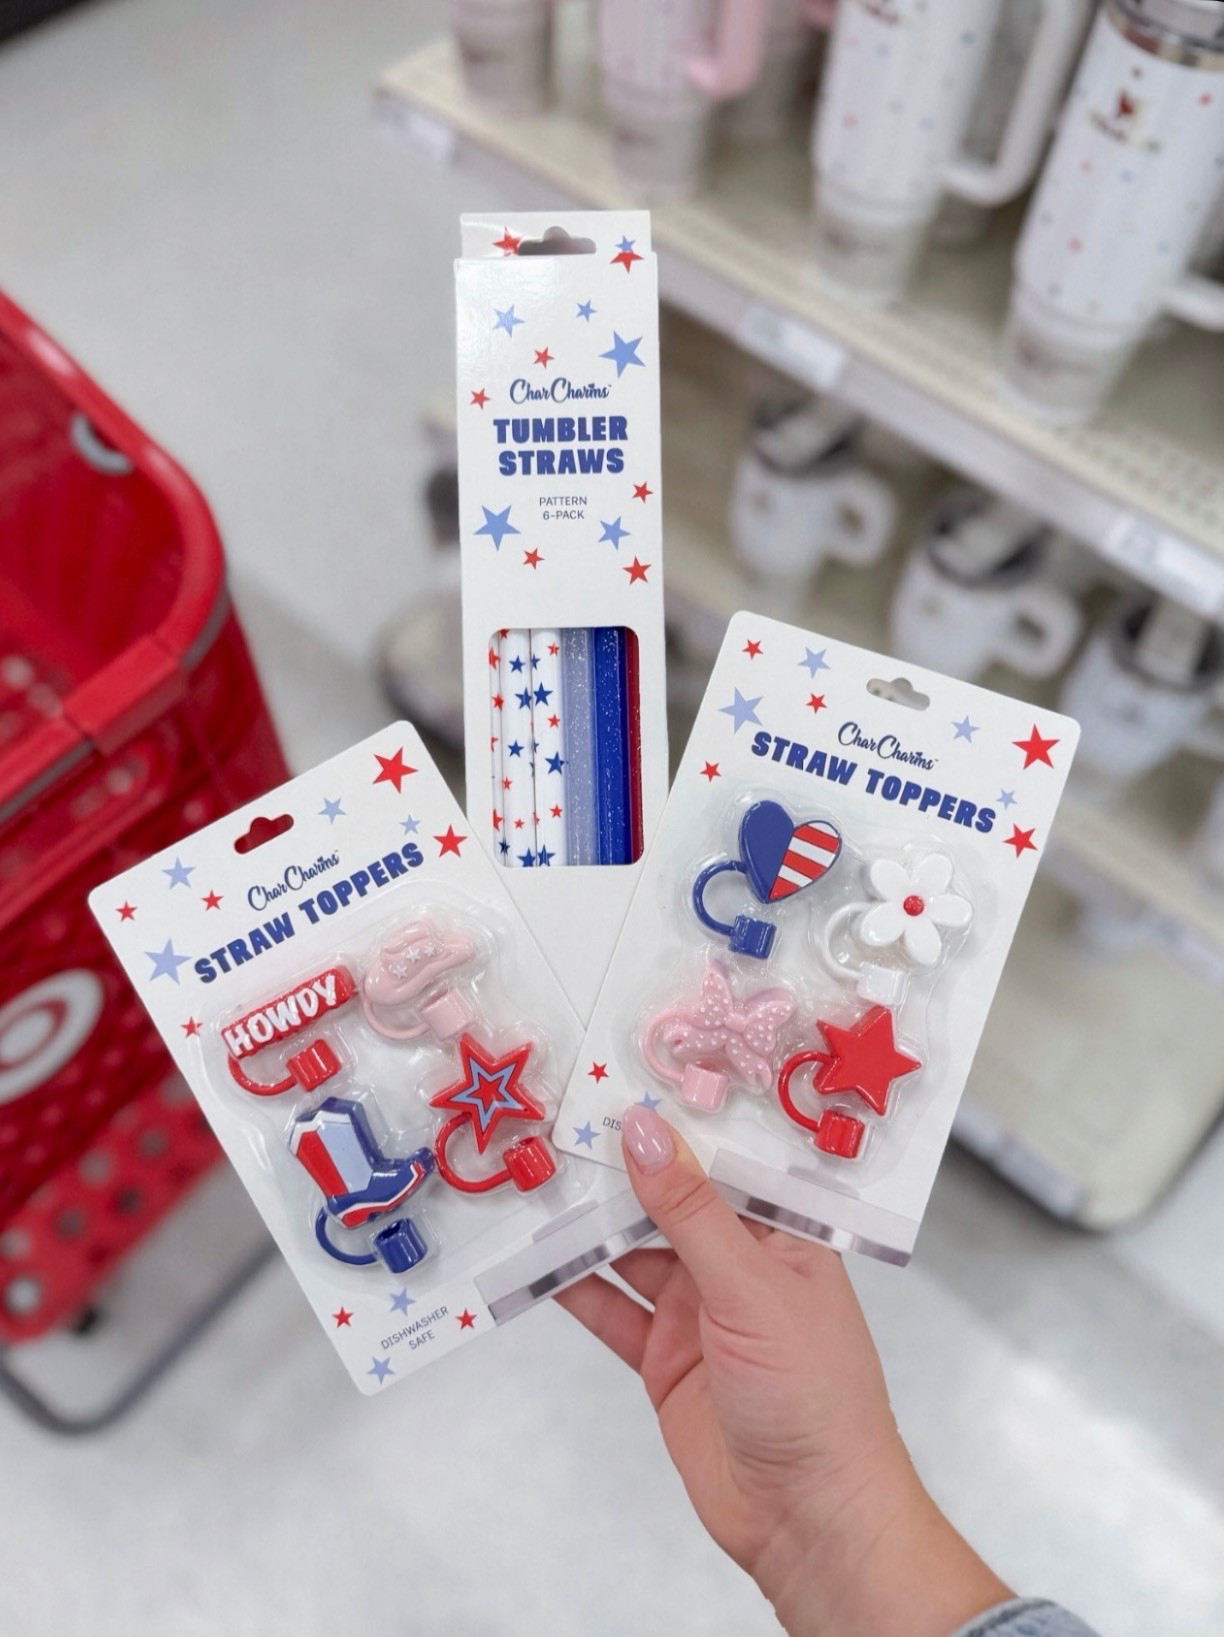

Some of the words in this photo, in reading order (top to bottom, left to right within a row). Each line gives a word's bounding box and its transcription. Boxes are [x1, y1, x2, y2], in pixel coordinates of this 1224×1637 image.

[493, 415, 628, 444] TUMBLER
[498, 447, 624, 477] STRAWS
[539, 496, 588, 507] PATTERN
[542, 510, 585, 521] 6-PACK
[751, 731, 858, 786] STRAW
[865, 768, 997, 834] TOPPERS
[193, 912, 296, 984] STRAW
[298, 842, 425, 925] TOPPERS
[223, 974, 338, 1057] HOWDY
[380, 1306, 449, 1350] DISHWASHER
[408, 1329, 435, 1350] SAFE
